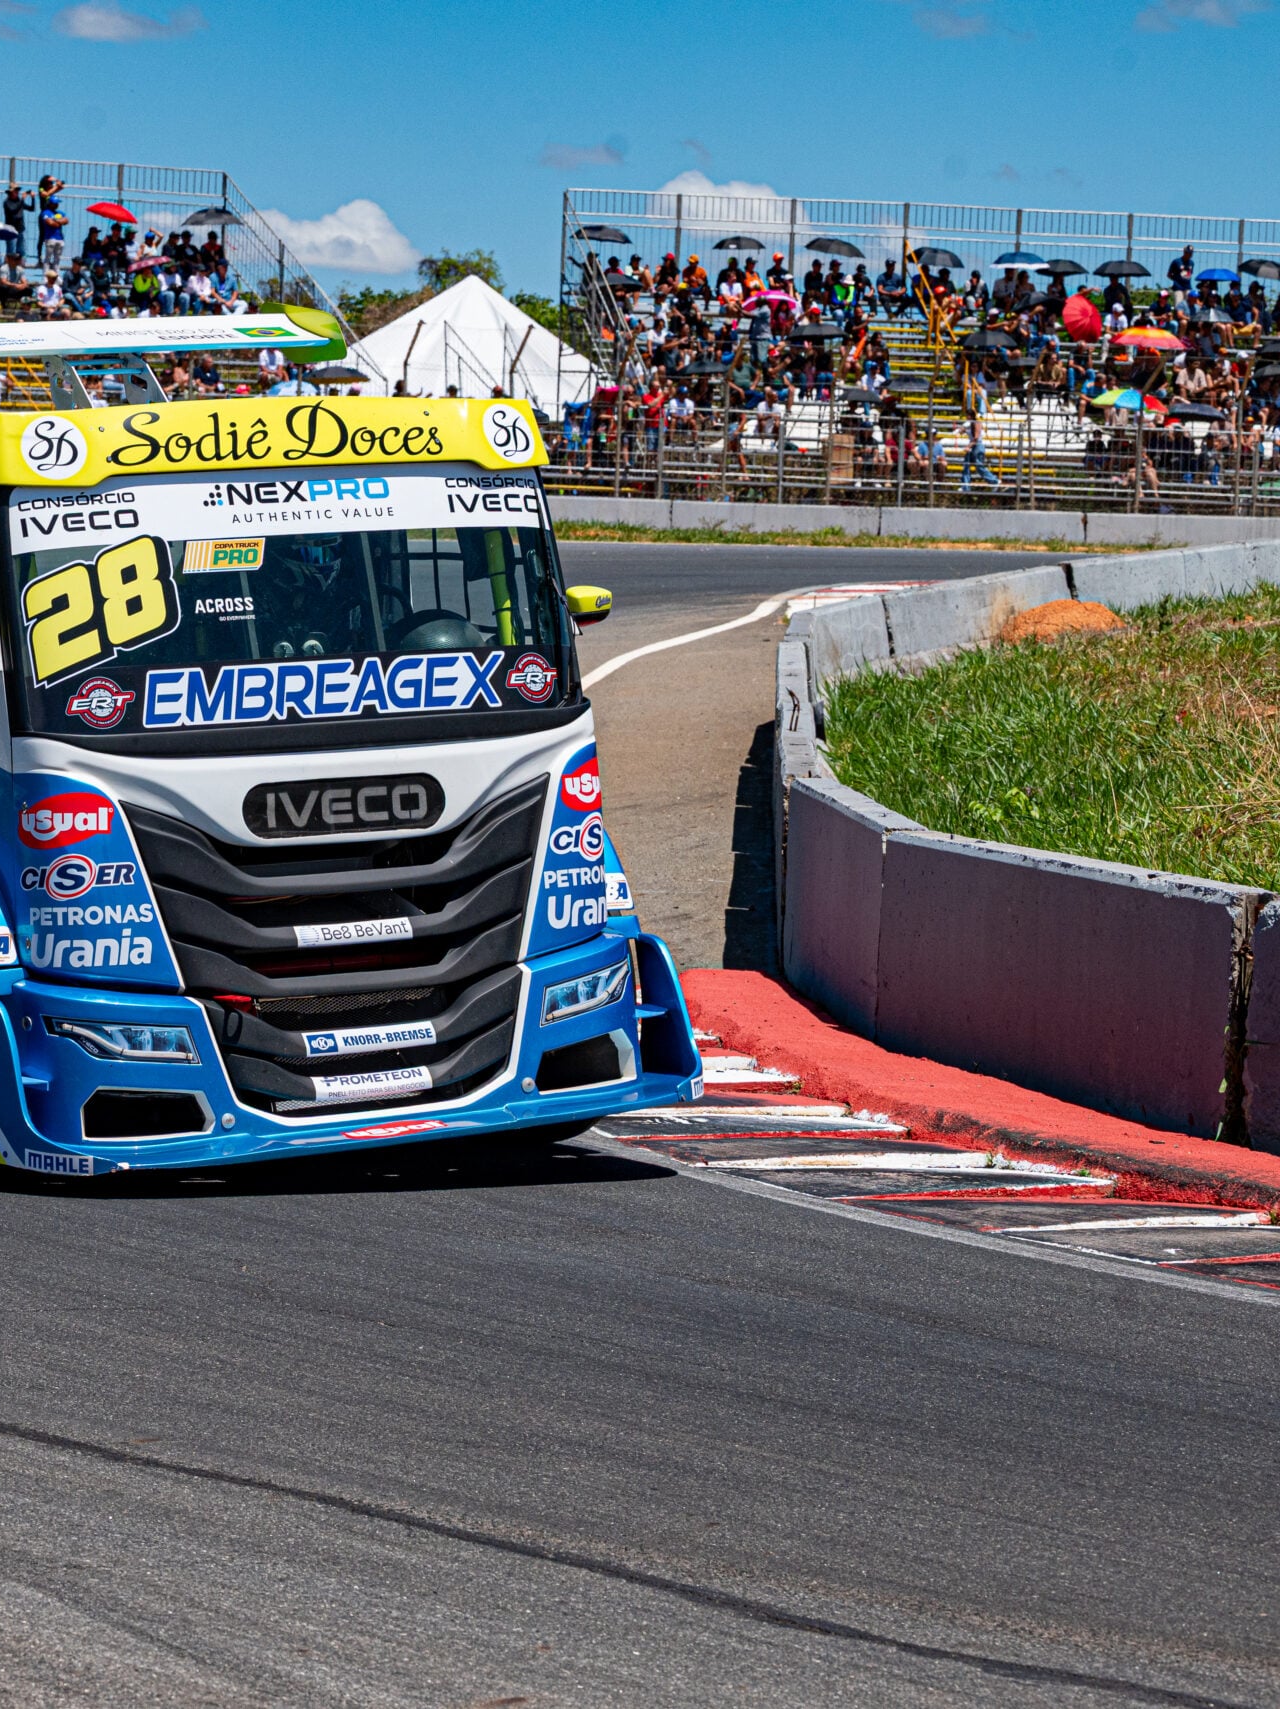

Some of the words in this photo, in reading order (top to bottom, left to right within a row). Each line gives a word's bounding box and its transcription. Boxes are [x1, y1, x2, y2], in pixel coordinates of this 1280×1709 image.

[110, 411, 271, 466] Sodiê
[283, 401, 444, 461] Doces
[226, 477, 389, 506] NEXPRO
[444, 474, 535, 489] CONSÓRCIO
[17, 491, 135, 512] CONSÓRCIO
[20, 508, 139, 538] IVECO
[232, 509, 333, 524] AUTHENTIC
[341, 507, 395, 519] VALUE
[213, 548, 258, 566] PRO
[23, 536, 172, 684] 28
[195, 597, 254, 614] ACROSS
[510, 671, 557, 684] ERT
[144, 653, 503, 726] EMBREAGEX
[70, 694, 131, 712] ERT
[266, 784, 428, 828] IVECO
[21, 859, 135, 894] CISER
[29, 903, 154, 927] PETRONAS
[320, 925, 352, 941] Be8
[353, 920, 409, 937] BeVant
[30, 928, 153, 968] Urania
[342, 1027, 434, 1047] KNORR-BREMSE
[320, 1068, 423, 1087] PROMETEON
[348, 1089, 367, 1097] FEITO
[367, 1087, 384, 1095] PARA
[384, 1085, 397, 1093] SEU
[28, 1151, 90, 1174] MAHLE
